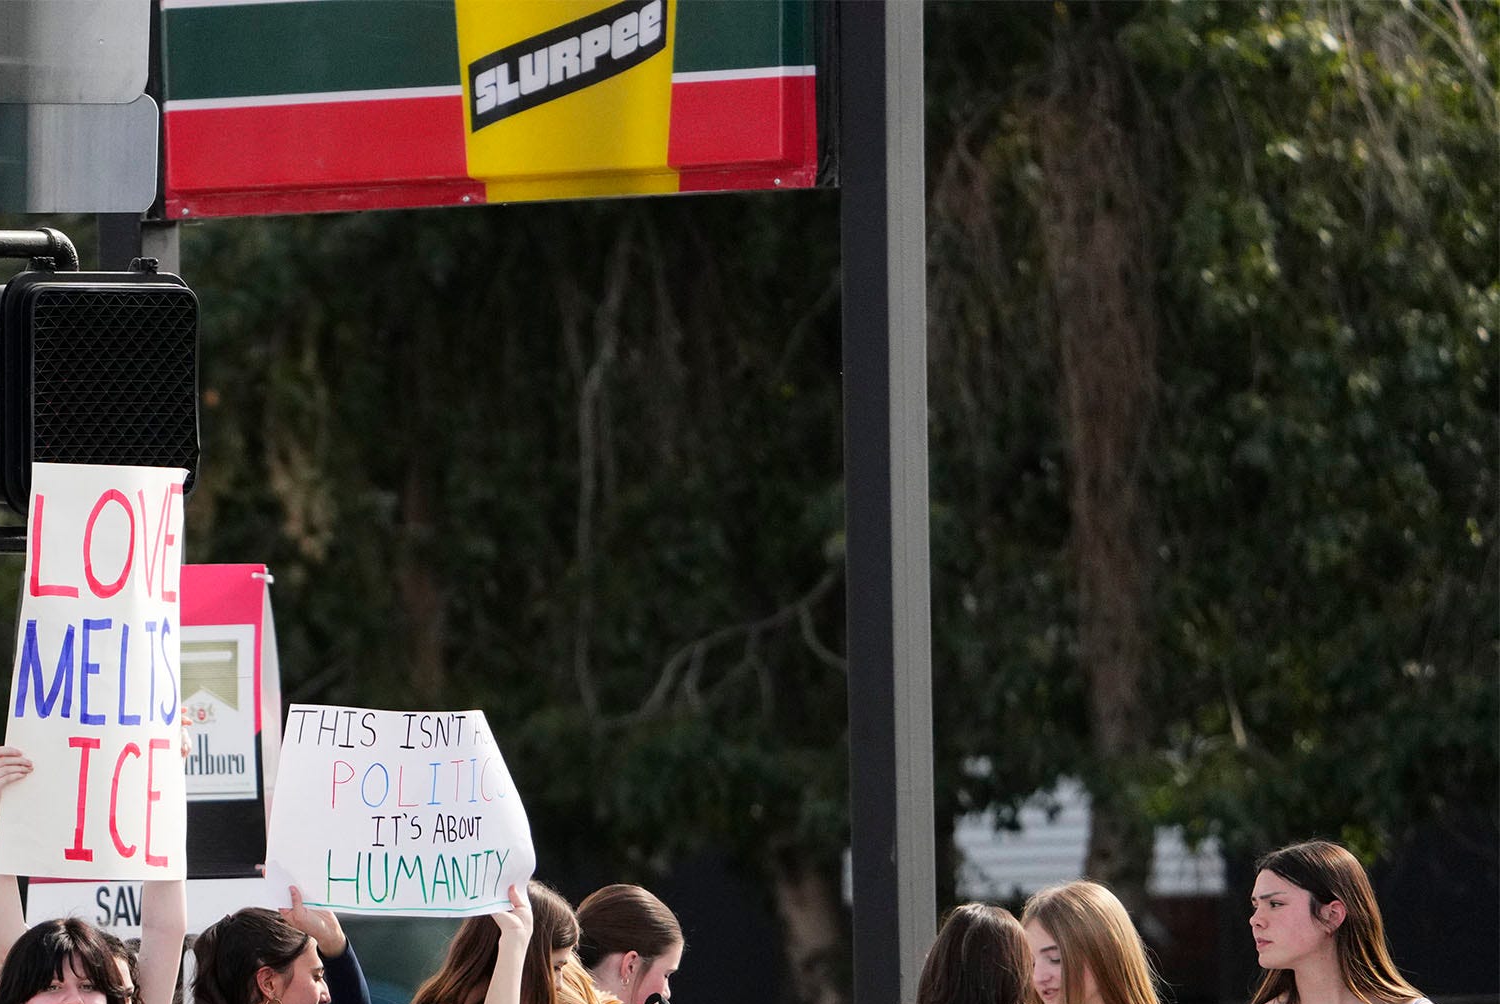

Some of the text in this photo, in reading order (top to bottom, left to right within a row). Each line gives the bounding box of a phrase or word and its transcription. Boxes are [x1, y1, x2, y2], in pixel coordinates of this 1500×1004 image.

[28, 482, 184, 603] LOVE
[14, 616, 177, 726] MELTS
[291, 709, 377, 748] THIS
[399, 712, 467, 749] ISN'T
[64, 736, 171, 868] ICE
[371, 812, 483, 847] IT'S ABOUT
[327, 848, 510, 905] HUMANITY
